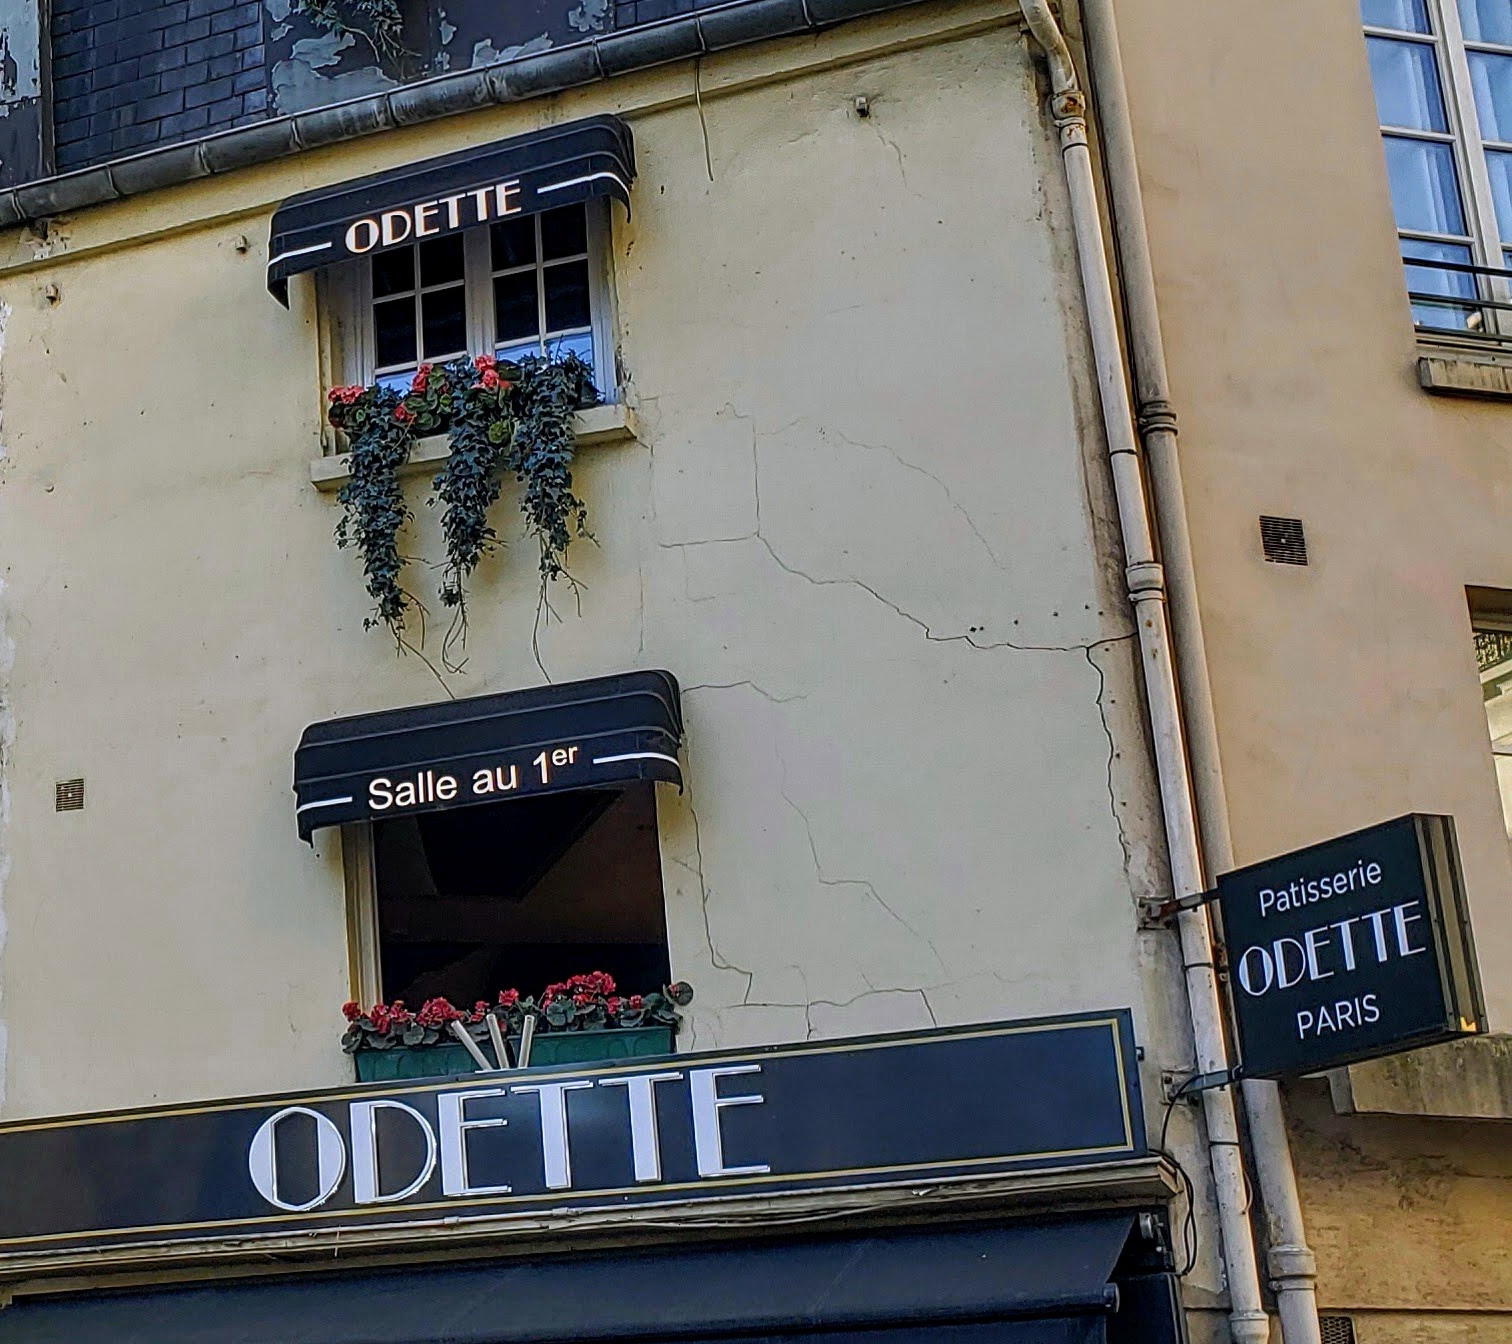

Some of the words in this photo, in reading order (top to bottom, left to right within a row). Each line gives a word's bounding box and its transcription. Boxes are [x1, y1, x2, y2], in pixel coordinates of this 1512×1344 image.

[345, 179, 522, 253] ODETTE
[368, 770, 458, 810] Salle
[472, 764, 517, 794] au
[533, 745, 578, 784] 1er
[1259, 859, 1382, 917] Patisserie
[1239, 900, 1426, 996] ODETTE
[1296, 994, 1380, 1039] PARIS
[248, 1064, 771, 1211] ODETTE
